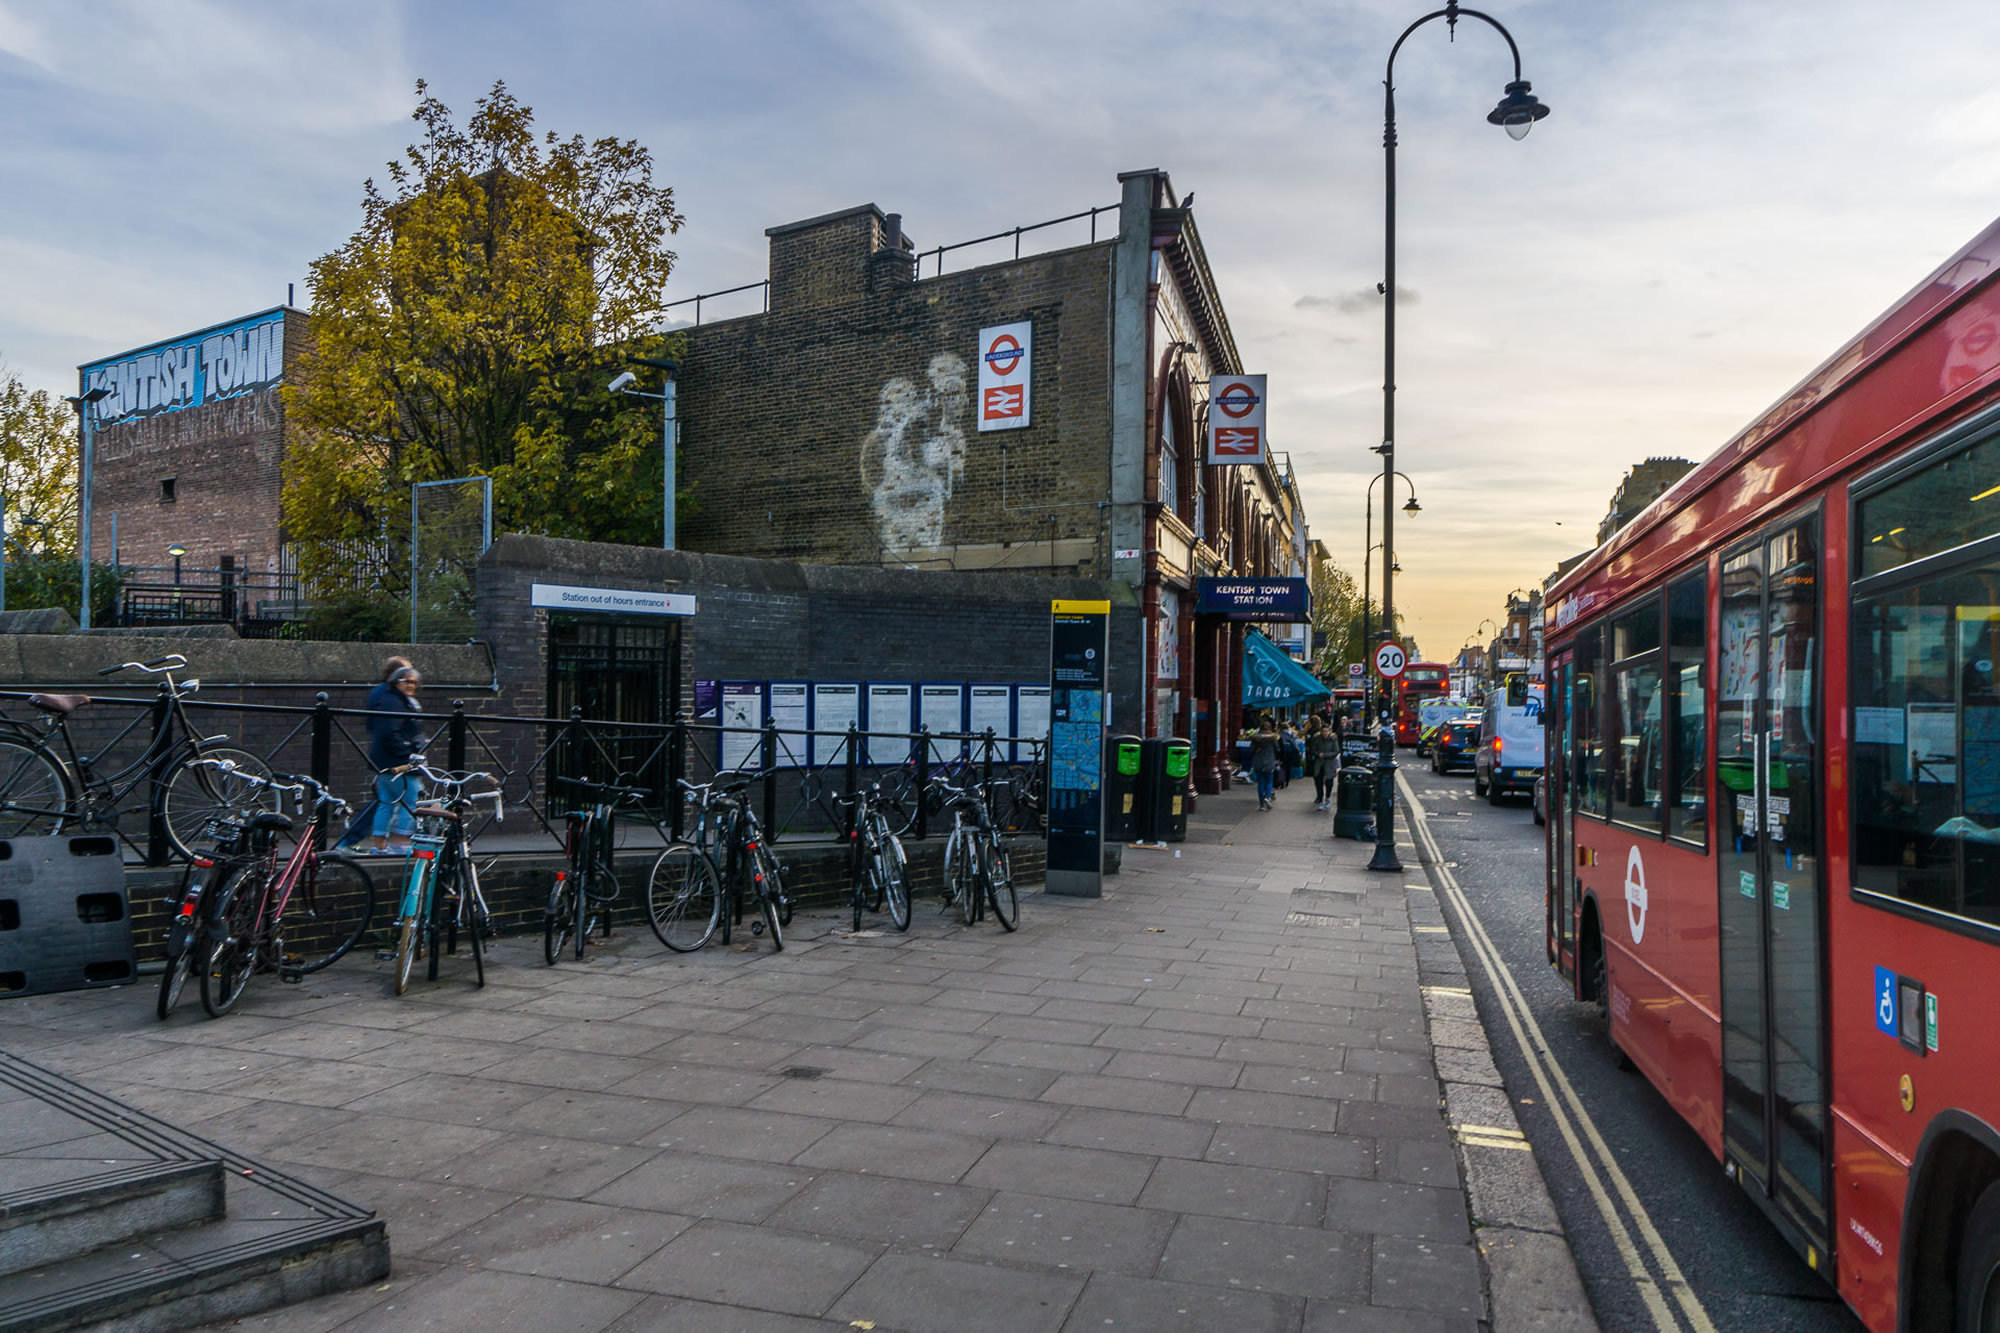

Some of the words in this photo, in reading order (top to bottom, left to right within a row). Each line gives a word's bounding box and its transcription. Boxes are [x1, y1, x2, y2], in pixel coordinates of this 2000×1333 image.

[986, 349, 1023, 360] UNDERGROUND
[88, 345, 197, 420] KENTISH
[201, 321, 285, 399] TOWN
[1216, 585, 1255, 594] KENTISH
[1260, 586, 1289, 595] TOWN
[562, 592, 589, 603] Station
[604, 595, 612, 603] of
[613, 597, 633, 606] hours
[635, 599, 665, 608] entrance
[1233, 595, 1273, 604] STATION
[1380, 653, 1403, 669] 20
[1247, 685, 1291, 699] TACOS
